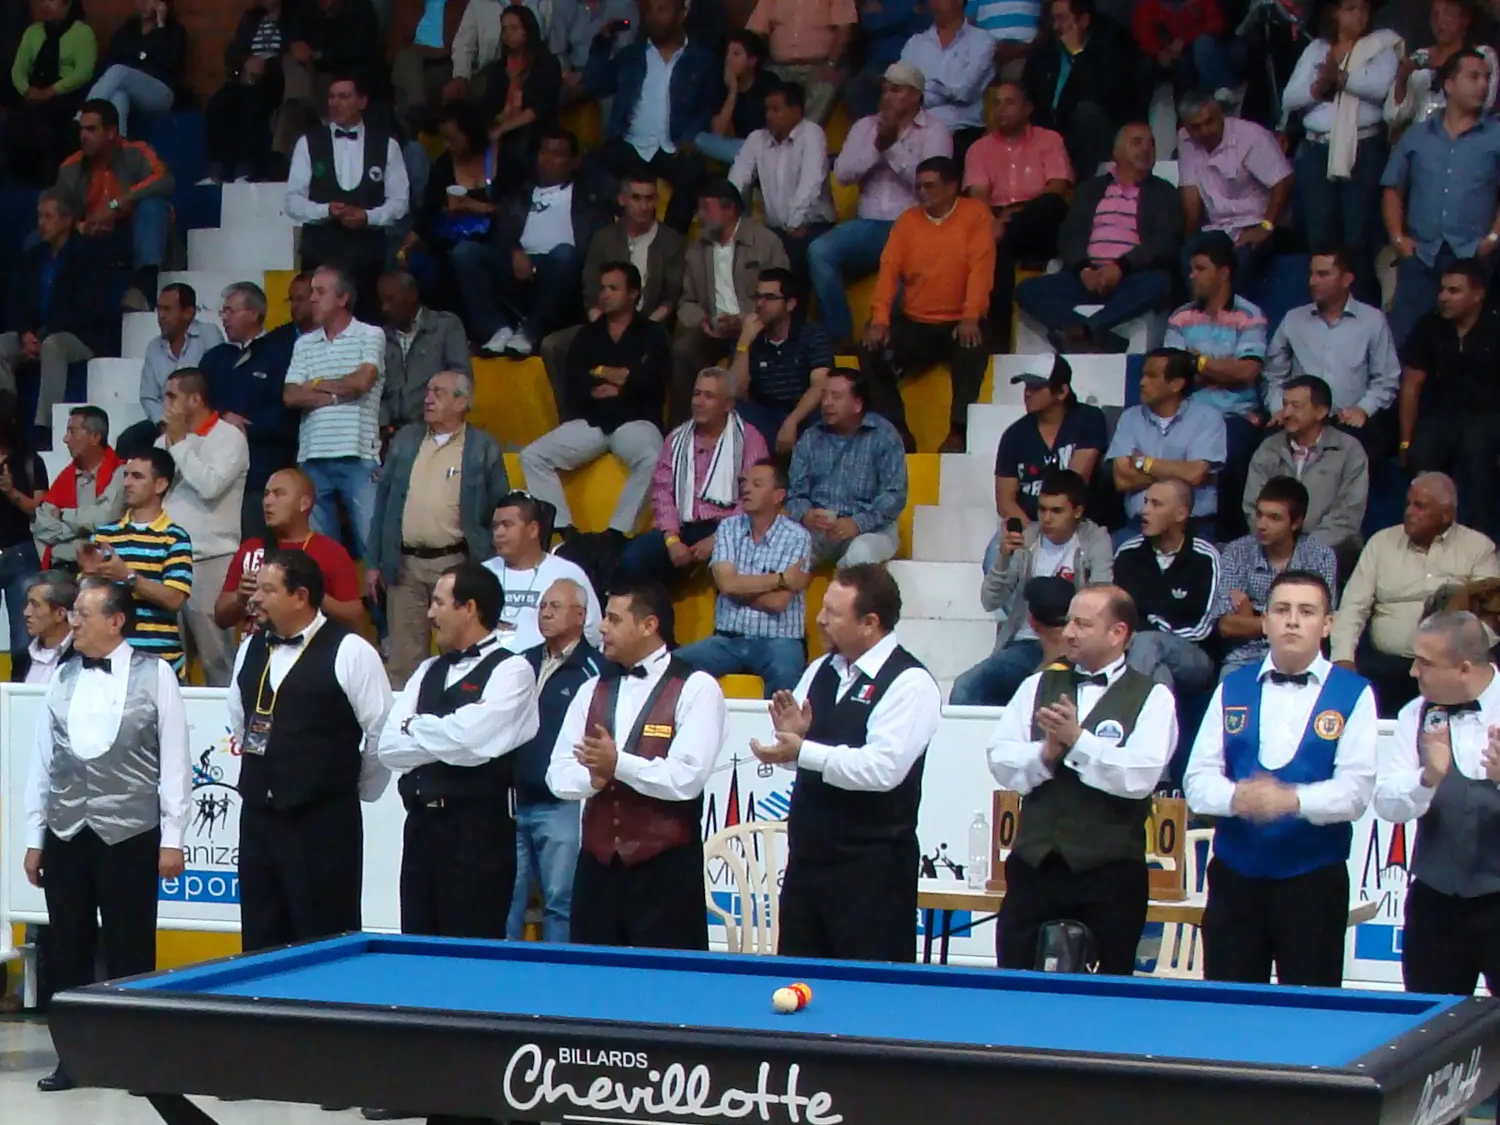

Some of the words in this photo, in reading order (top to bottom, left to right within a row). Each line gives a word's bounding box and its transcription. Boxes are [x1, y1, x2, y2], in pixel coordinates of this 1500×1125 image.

[1000, 811, 1015, 847] 0
[1159, 818, 1176, 854] 0
[558, 1047, 649, 1069] BILLARDS
[503, 1043, 843, 1125] Chevillotte
